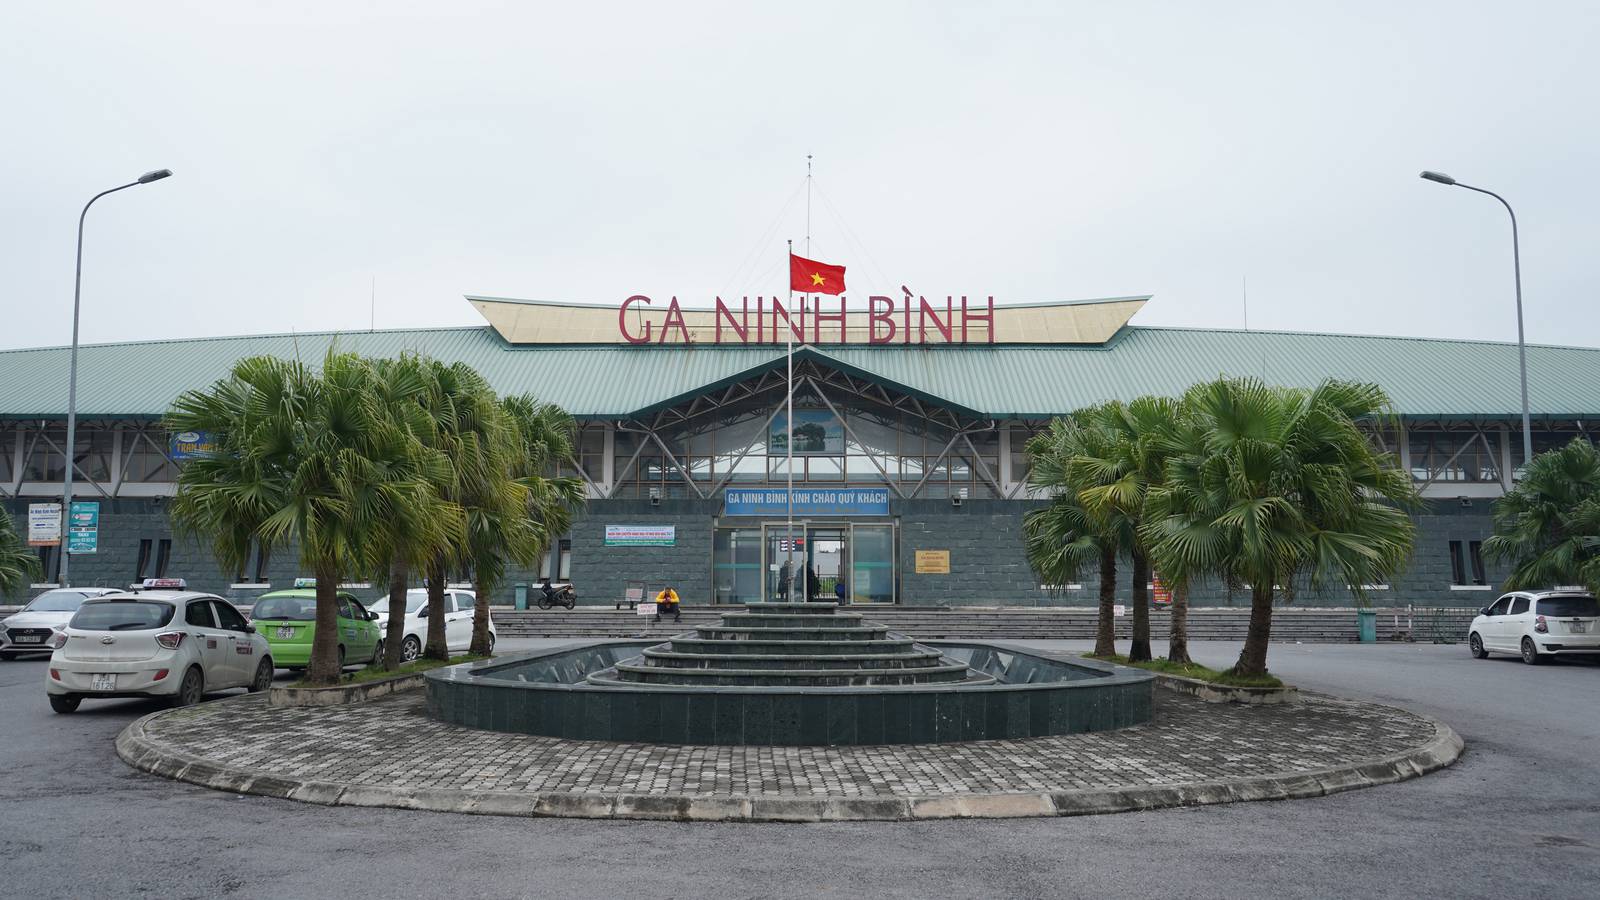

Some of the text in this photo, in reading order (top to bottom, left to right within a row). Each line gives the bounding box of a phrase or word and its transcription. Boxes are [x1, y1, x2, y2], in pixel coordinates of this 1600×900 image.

[619, 285, 994, 344] GA NINH BÌNH
[728, 493, 740, 504] GA
[742, 493, 764, 504] NINH
[766, 490, 787, 504] BÌNH
[812, 490, 836, 504] CHÀO
[838, 490, 855, 505] QUÝ
[857, 490, 887, 504] KHÁCH
